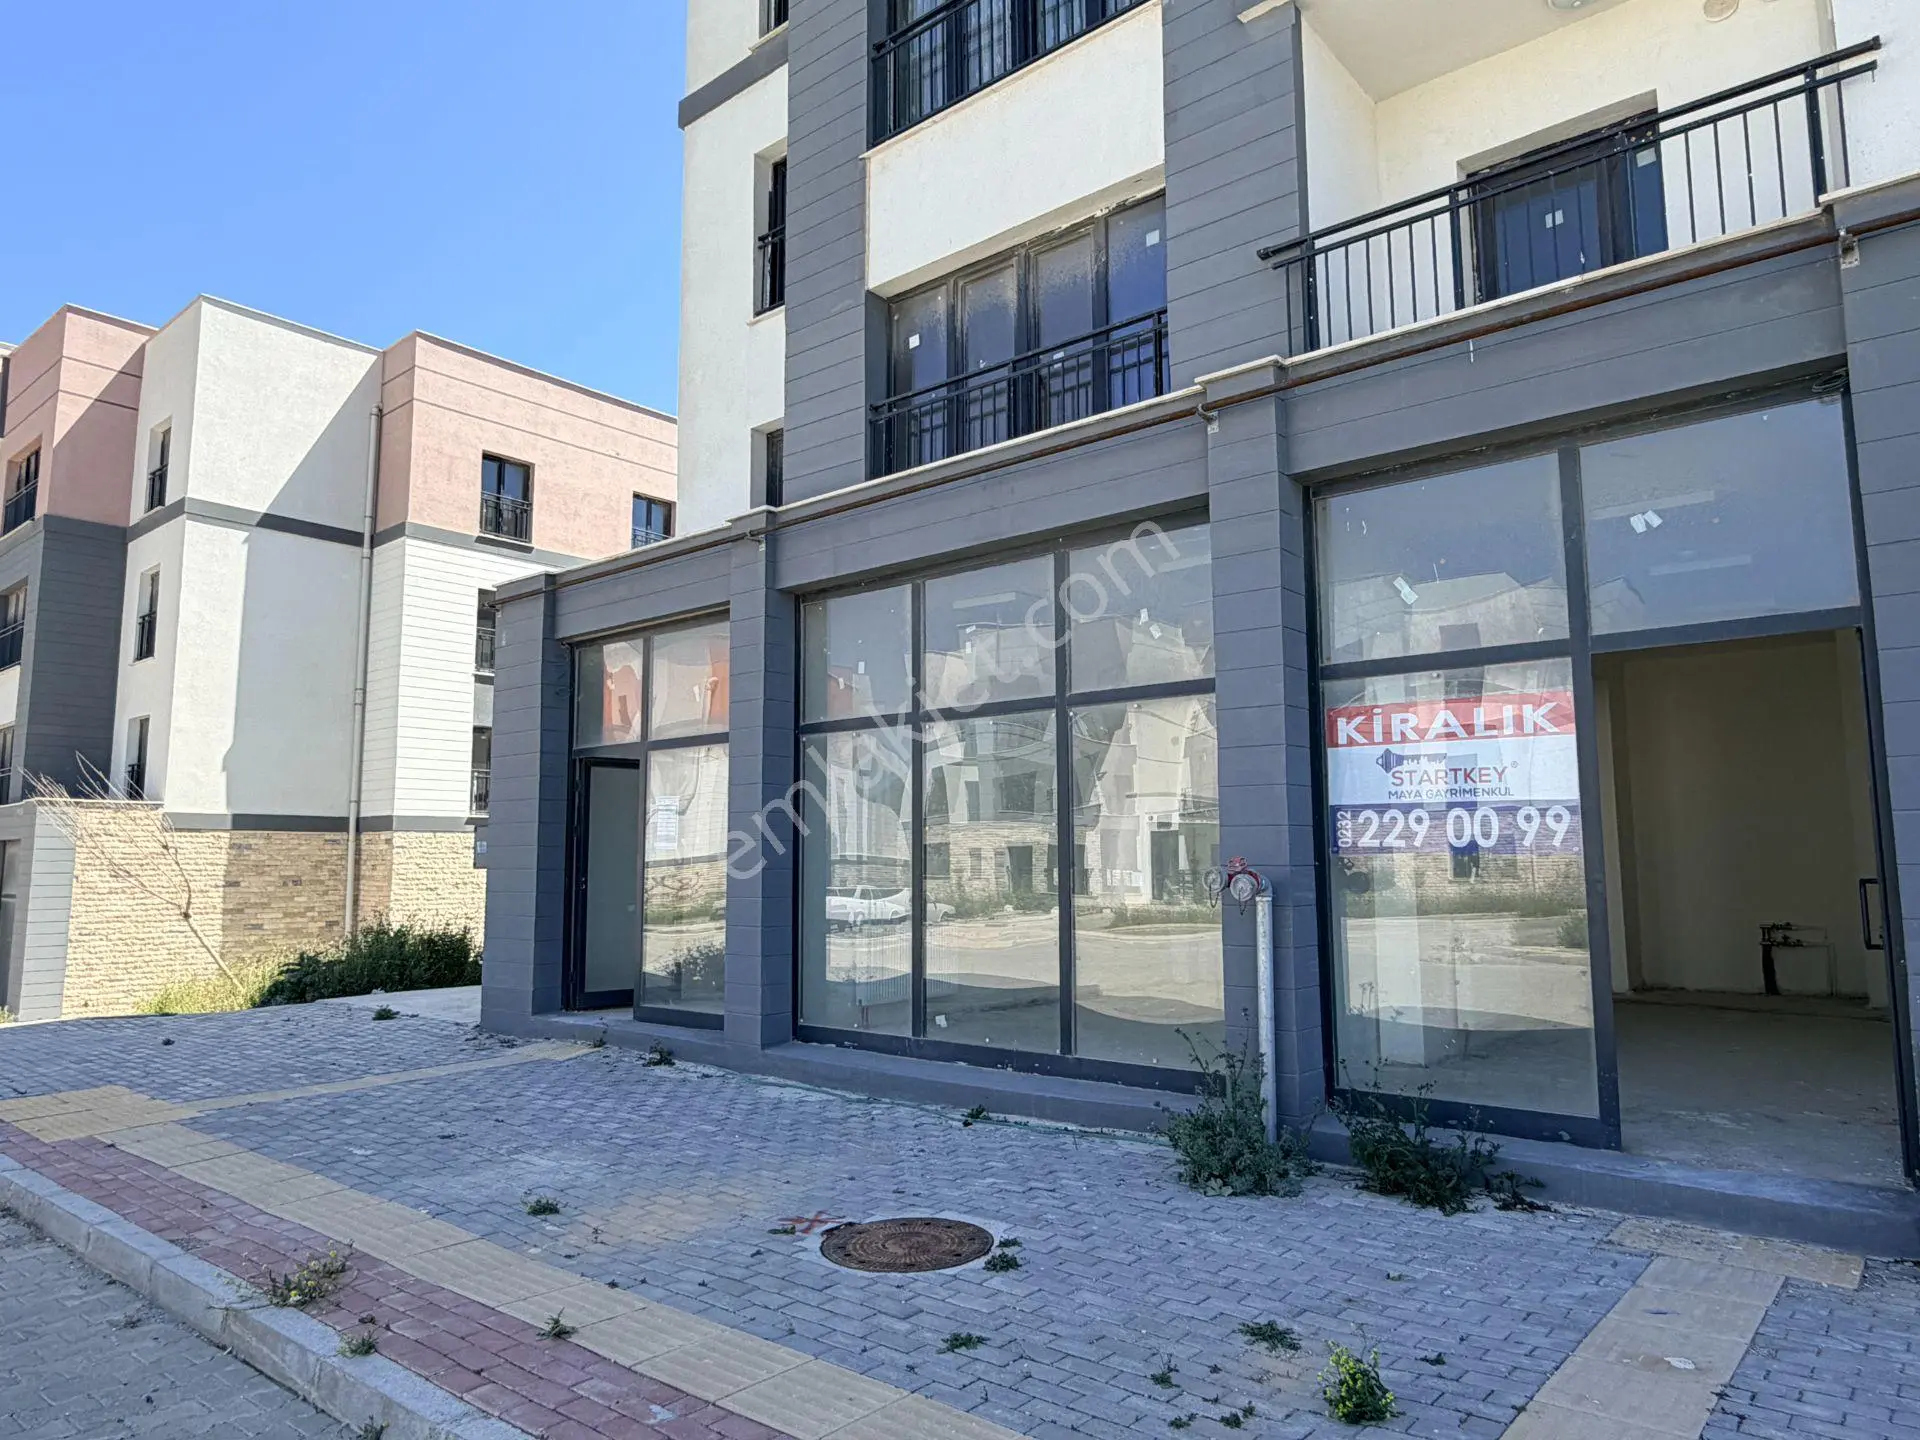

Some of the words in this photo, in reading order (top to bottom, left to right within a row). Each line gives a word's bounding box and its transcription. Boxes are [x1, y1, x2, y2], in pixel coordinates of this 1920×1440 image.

[1336, 702, 1561, 745] KİRALIK
[1388, 789, 1423, 800] MAYA
[1425, 786, 1515, 800] GAYRİMENKUL
[1391, 766, 1508, 787] STARTKEY
[1337, 810, 1352, 848] 0232
[1357, 808, 1431, 848] 229
[1446, 806, 1499, 848] 00
[1516, 804, 1572, 848] 99
